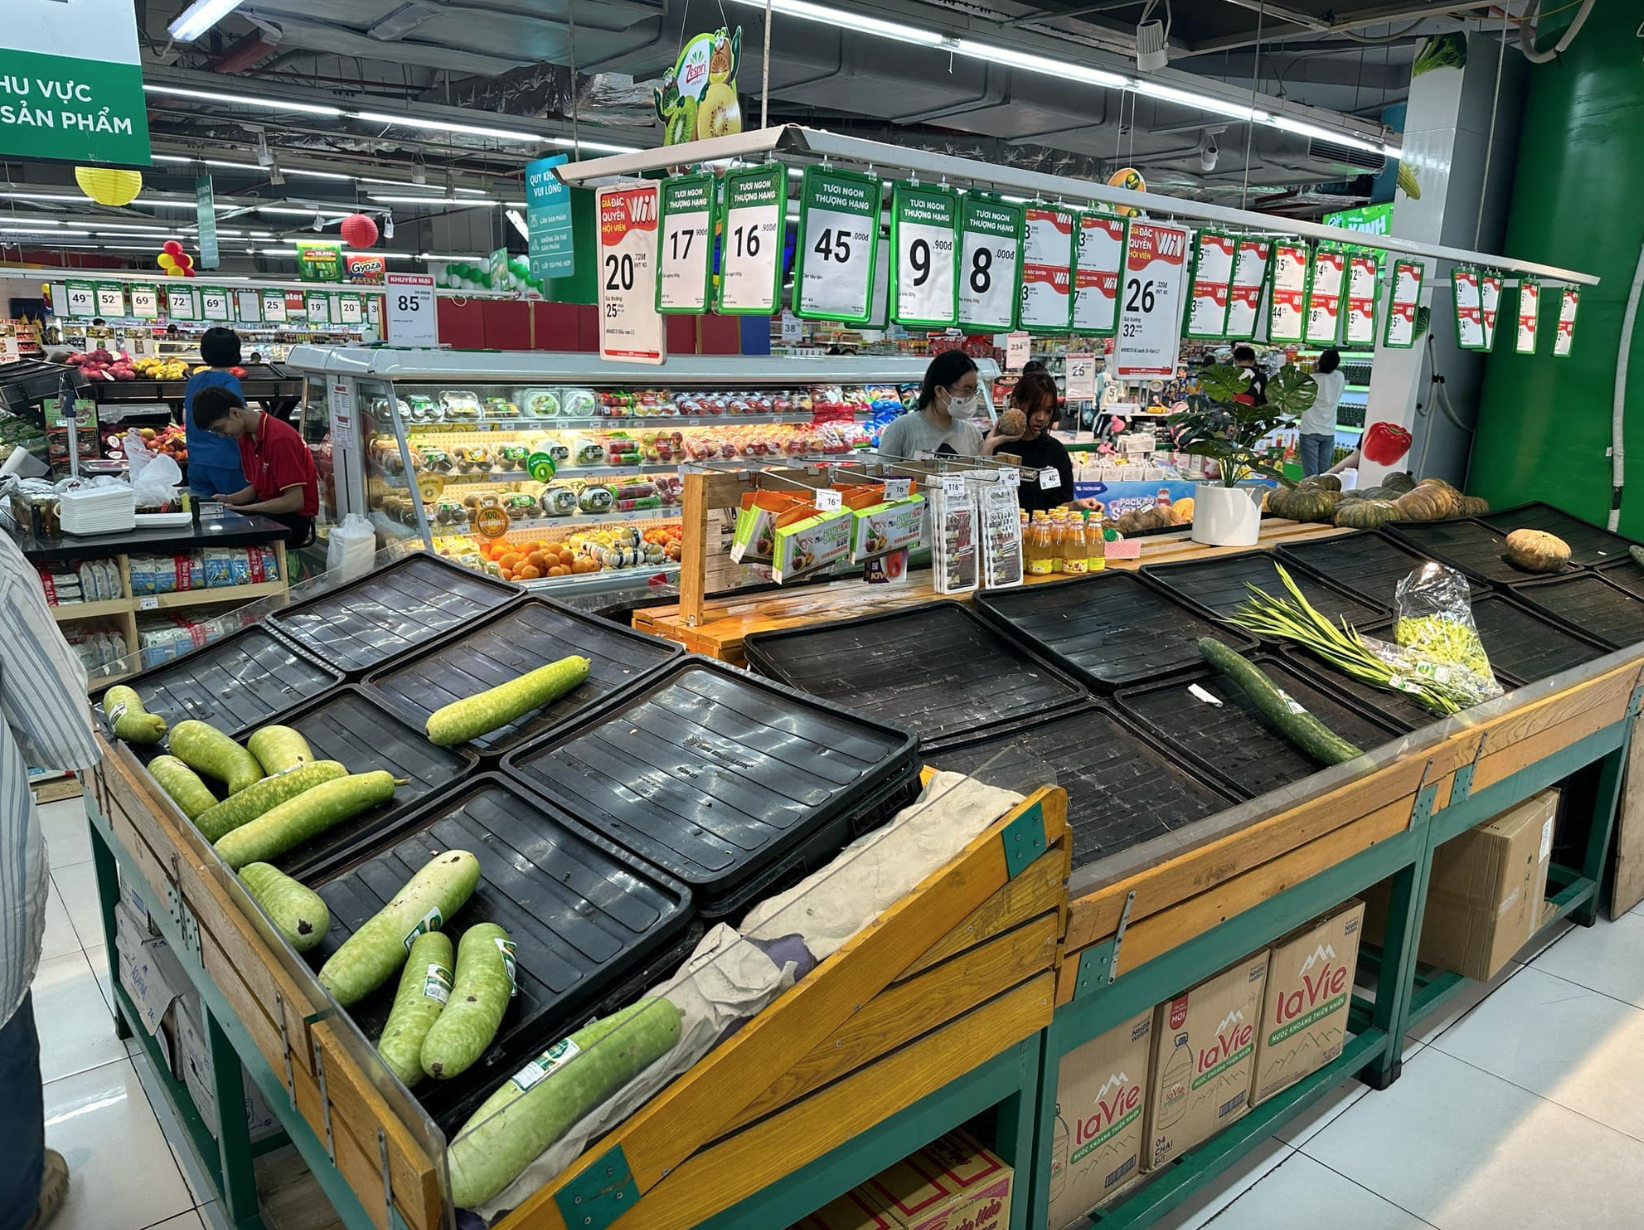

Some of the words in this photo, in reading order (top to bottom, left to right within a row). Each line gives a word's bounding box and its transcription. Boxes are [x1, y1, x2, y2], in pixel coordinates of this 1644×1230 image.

[36, 79, 93, 104] VỰC
[0, 100, 54, 128] SẢN
[61, 106, 133, 135] PHẨM
[740, 182, 753, 191] TƯƠI
[754, 180, 772, 190] NGON
[823, 183, 841, 193] TƯƠI
[842, 188, 865, 198] NGON
[687, 188, 704, 197] NGON
[734, 193, 758, 203] THƯỢNG
[758, 190, 776, 201] HẠNG
[691, 198, 708, 207] HẠNG
[815, 193, 848, 206] THƯỢNG
[848, 198, 870, 210] HẠNG
[909, 199, 926, 209] TƯƠI
[926, 202, 945, 211] NGON
[904, 208, 932, 219] THƯỢNG
[932, 213, 950, 223] HẠNG
[975, 209, 991, 219] TƯƠI
[991, 214, 1011, 222] NGON
[969, 218, 997, 230] THƯỢNG
[996, 223, 1015, 233] HẠNG
[670, 229, 695, 260] 17
[734, 224, 760, 257] 16
[814, 228, 852, 263] 45
[351, 261, 382, 274] Gyoza
[909, 238, 931, 287] 9
[605, 253, 634, 291] 20
[970, 247, 993, 294] 8
[72, 294, 86, 303] 49
[101, 294, 115, 304] 52
[136, 296, 149, 305] 69
[173, 298, 185, 306] 72
[1126, 278, 1155, 313] 26
[206, 299, 219, 308] 69
[266, 301, 279, 310] 25
[310, 303, 321, 311] 19
[343, 303, 355, 312] 20
[398, 295, 420, 311] 85
[606, 303, 618, 318] 25
[785, 324, 796, 332] 38
[1123, 324, 1135, 338] 32
[1072, 366, 1085, 376] 25
[827, 498, 836, 506] 16
[1155, 1139, 1173, 1156] CHAI
